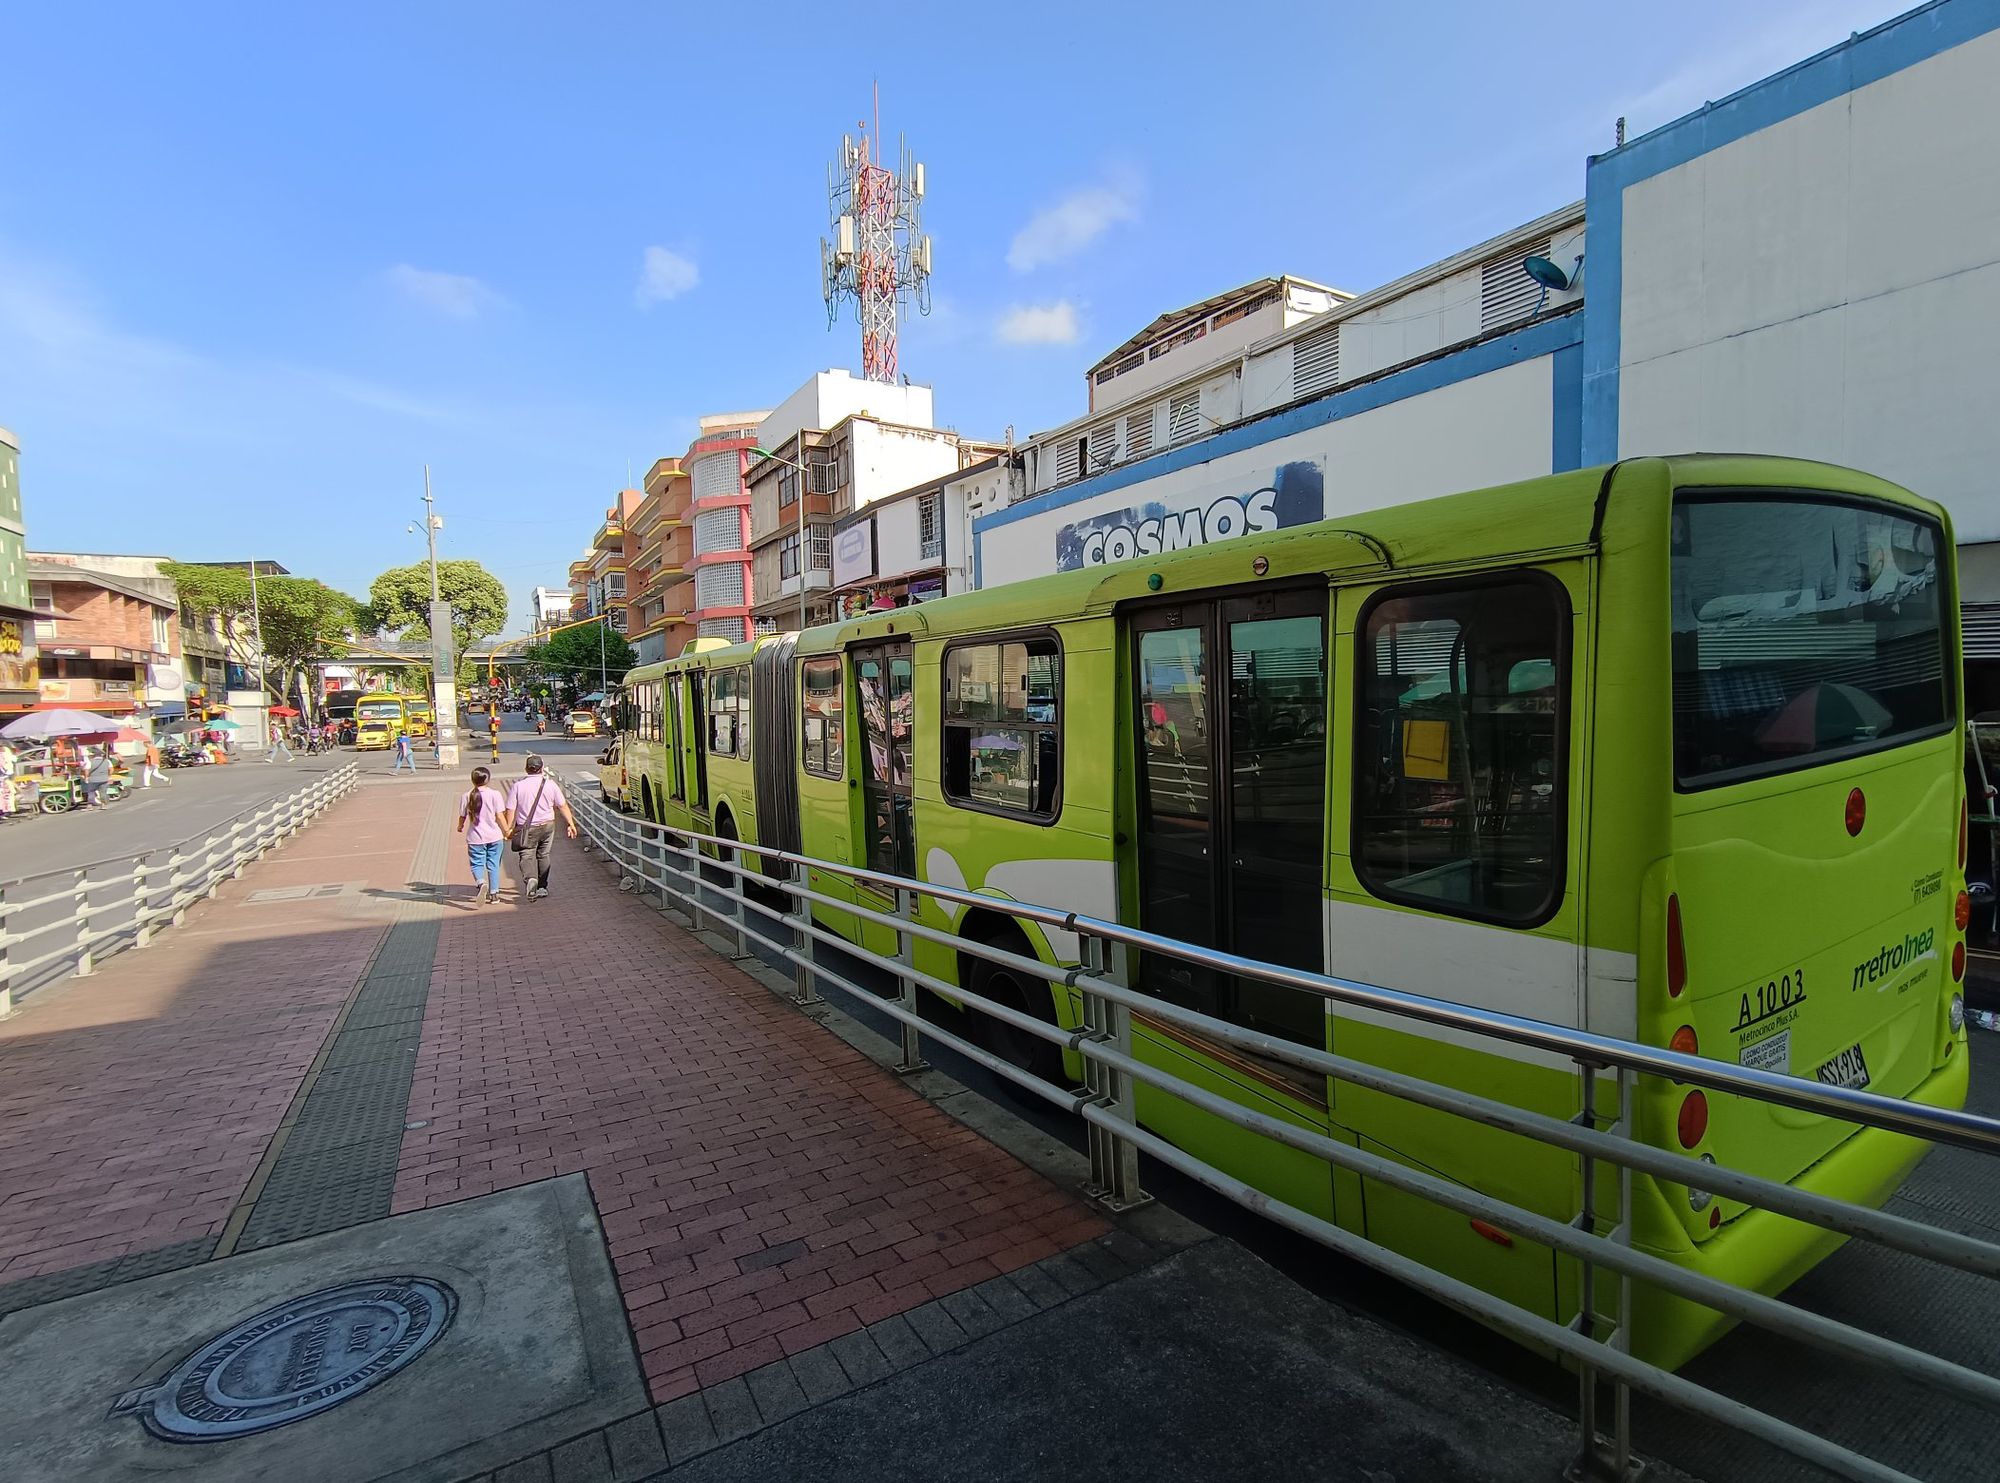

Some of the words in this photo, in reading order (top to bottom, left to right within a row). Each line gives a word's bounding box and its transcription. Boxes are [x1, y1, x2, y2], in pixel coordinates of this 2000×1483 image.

[1083, 487, 1278, 564] COSMOS
[293, 1315, 333, 1391] TELEFONOS
[346, 1323, 375, 1354] 2007
